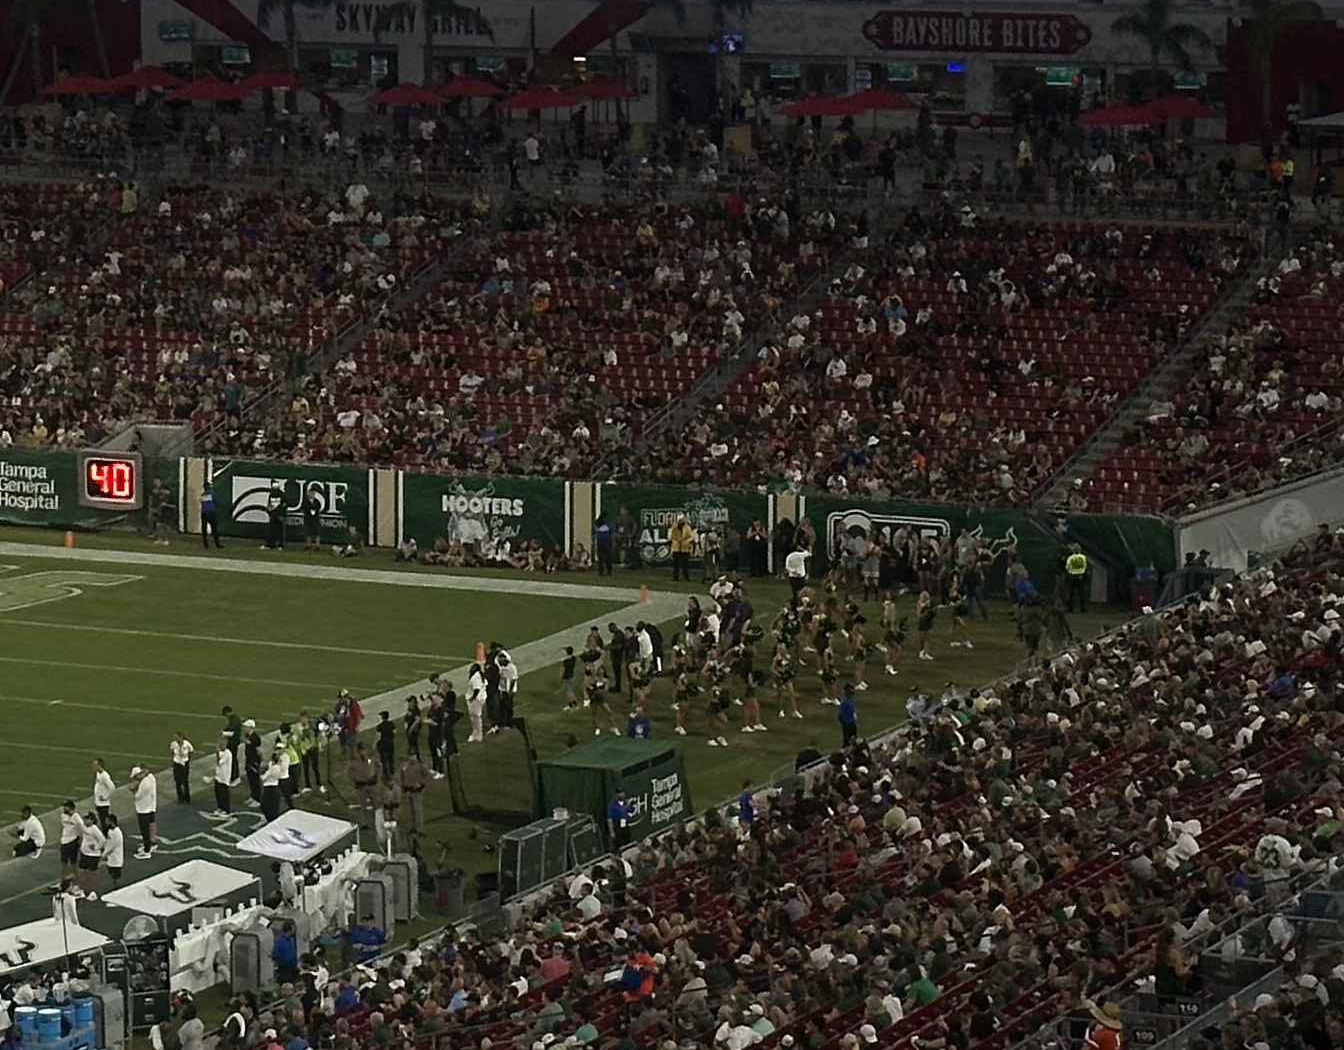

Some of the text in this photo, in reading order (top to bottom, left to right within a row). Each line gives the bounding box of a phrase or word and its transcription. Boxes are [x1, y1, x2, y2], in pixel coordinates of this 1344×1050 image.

[335, 3, 416, 33] SKYWAY
[892, 15, 1062, 48] BAYSHORE BITES
[90, 463, 131, 498] 40
[441, 494, 524, 516] HOOTERS
[650, 773, 679, 794] Tampa
[651, 784, 682, 809] General
[651, 798, 684, 825] Hospital
